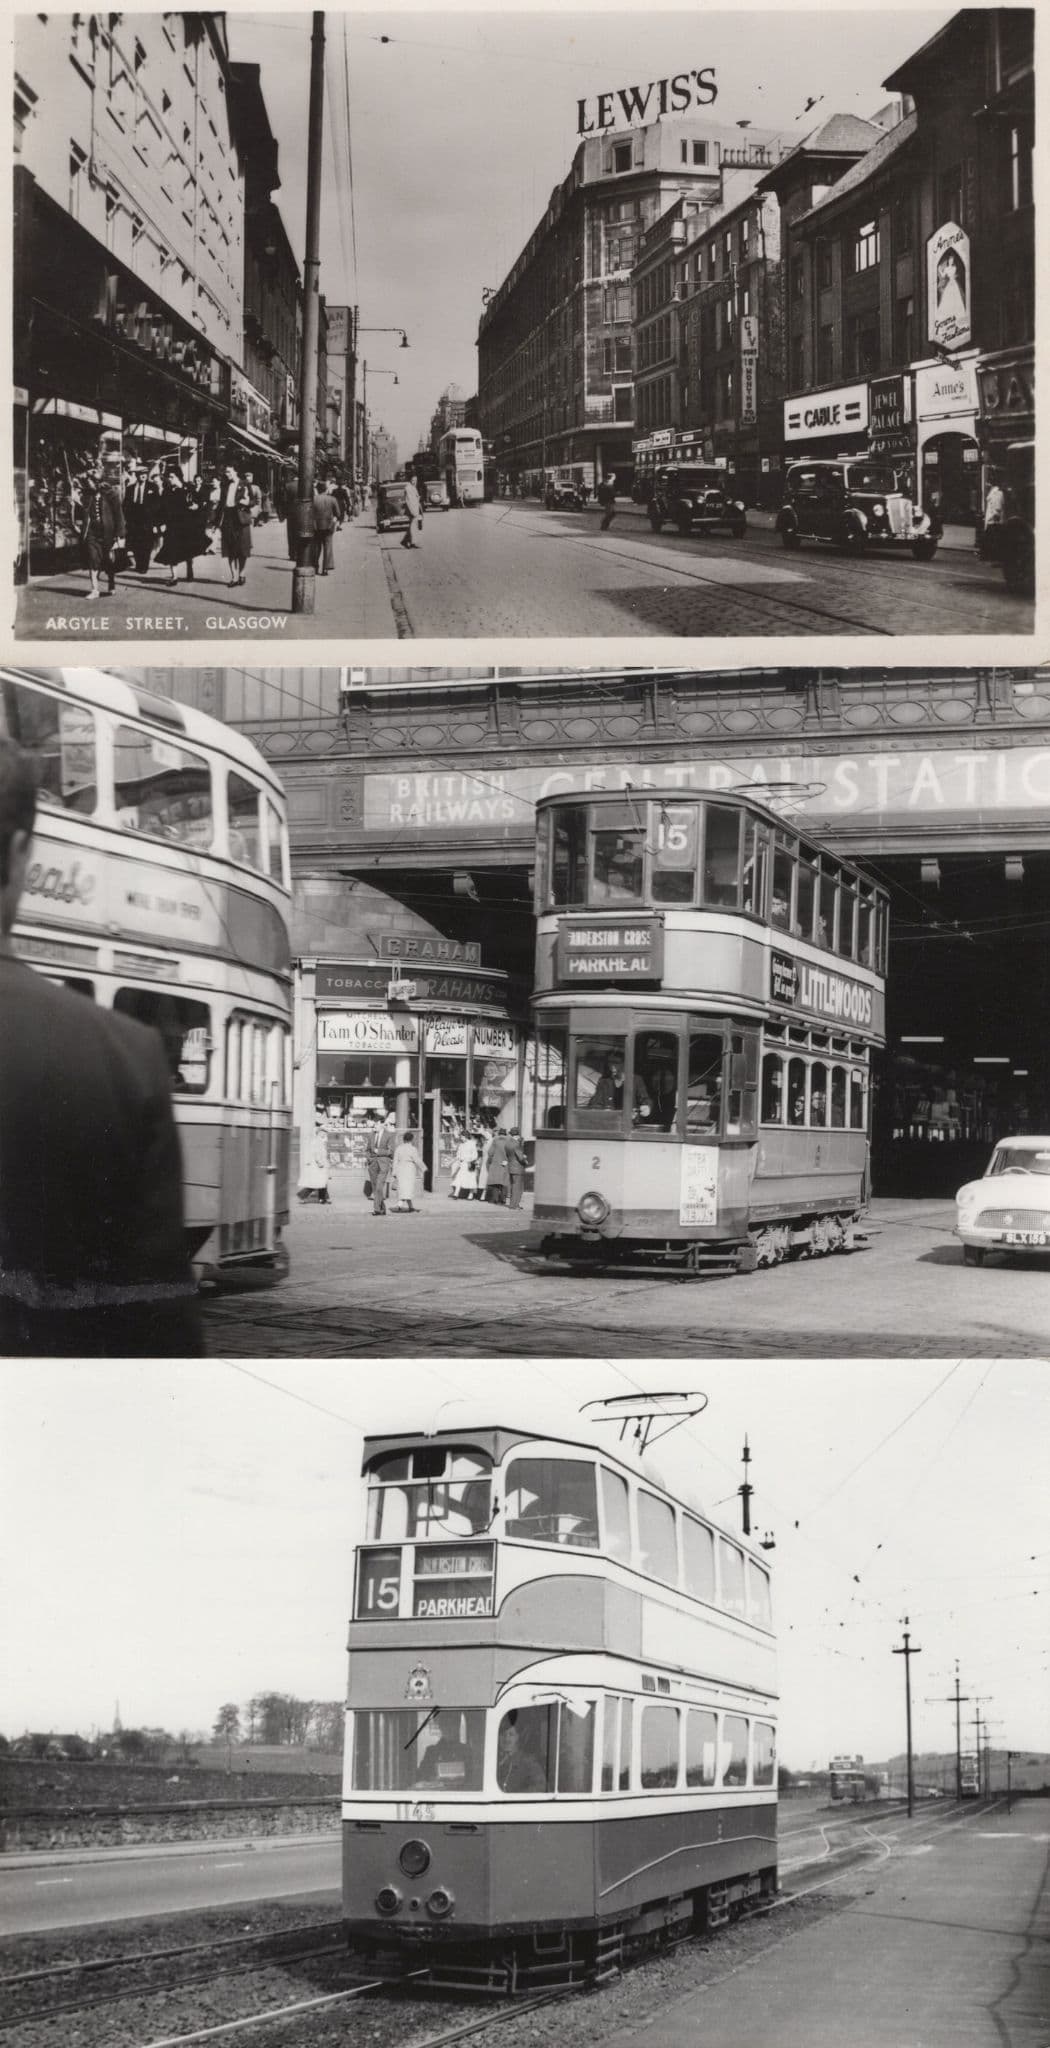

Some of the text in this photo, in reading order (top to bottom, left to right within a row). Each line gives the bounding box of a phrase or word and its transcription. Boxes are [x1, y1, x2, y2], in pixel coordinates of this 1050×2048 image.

[577, 68, 718, 134] LEWIS'S
[874, 392, 897, 410] JEWEL
[871, 411, 901, 430] PALACE
[399, 774, 505, 798] BRITISH
[390, 799, 515, 824] RAILWAYS
[658, 823, 688, 850] 15
[387, 938, 477, 964] GRAHAM
[802, 966, 872, 1023] LITTLEWOODS
[319, 1020, 416, 1042] Tam O'Shanter
[474, 1028, 514, 1051] NUMBER 3
[592, 1156, 601, 1169] 2
[367, 1577, 400, 1610] 15
